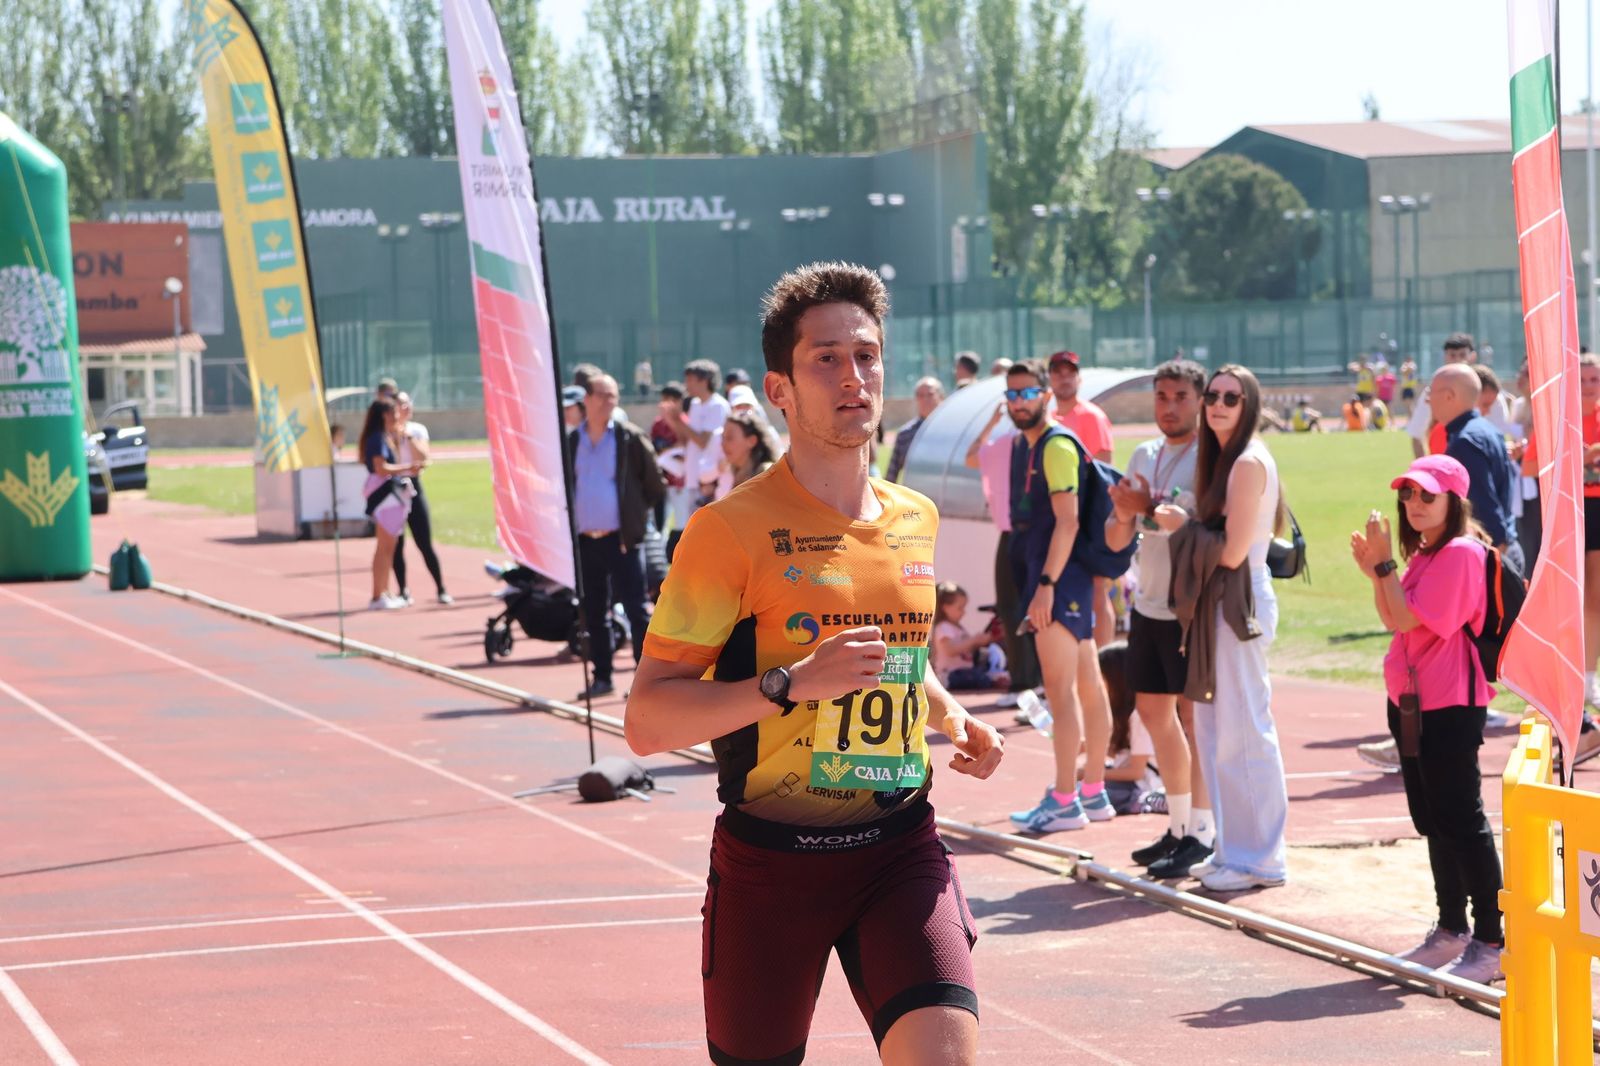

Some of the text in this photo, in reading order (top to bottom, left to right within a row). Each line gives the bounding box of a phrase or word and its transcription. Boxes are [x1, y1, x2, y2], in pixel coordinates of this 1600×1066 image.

[302, 208, 378, 227] AMORA
[541, 195, 737, 224] AJA RURAL
[73, 251, 124, 280] ON
[796, 535, 845, 545] Ayuntamiento
[809, 544, 847, 552] Salamanca
[822, 613, 894, 626] ESCUELA
[832, 687, 919, 750] 190
[793, 736, 813, 748] AL
[854, 766, 893, 781] CAJA
[797, 828, 880, 845] WONG
